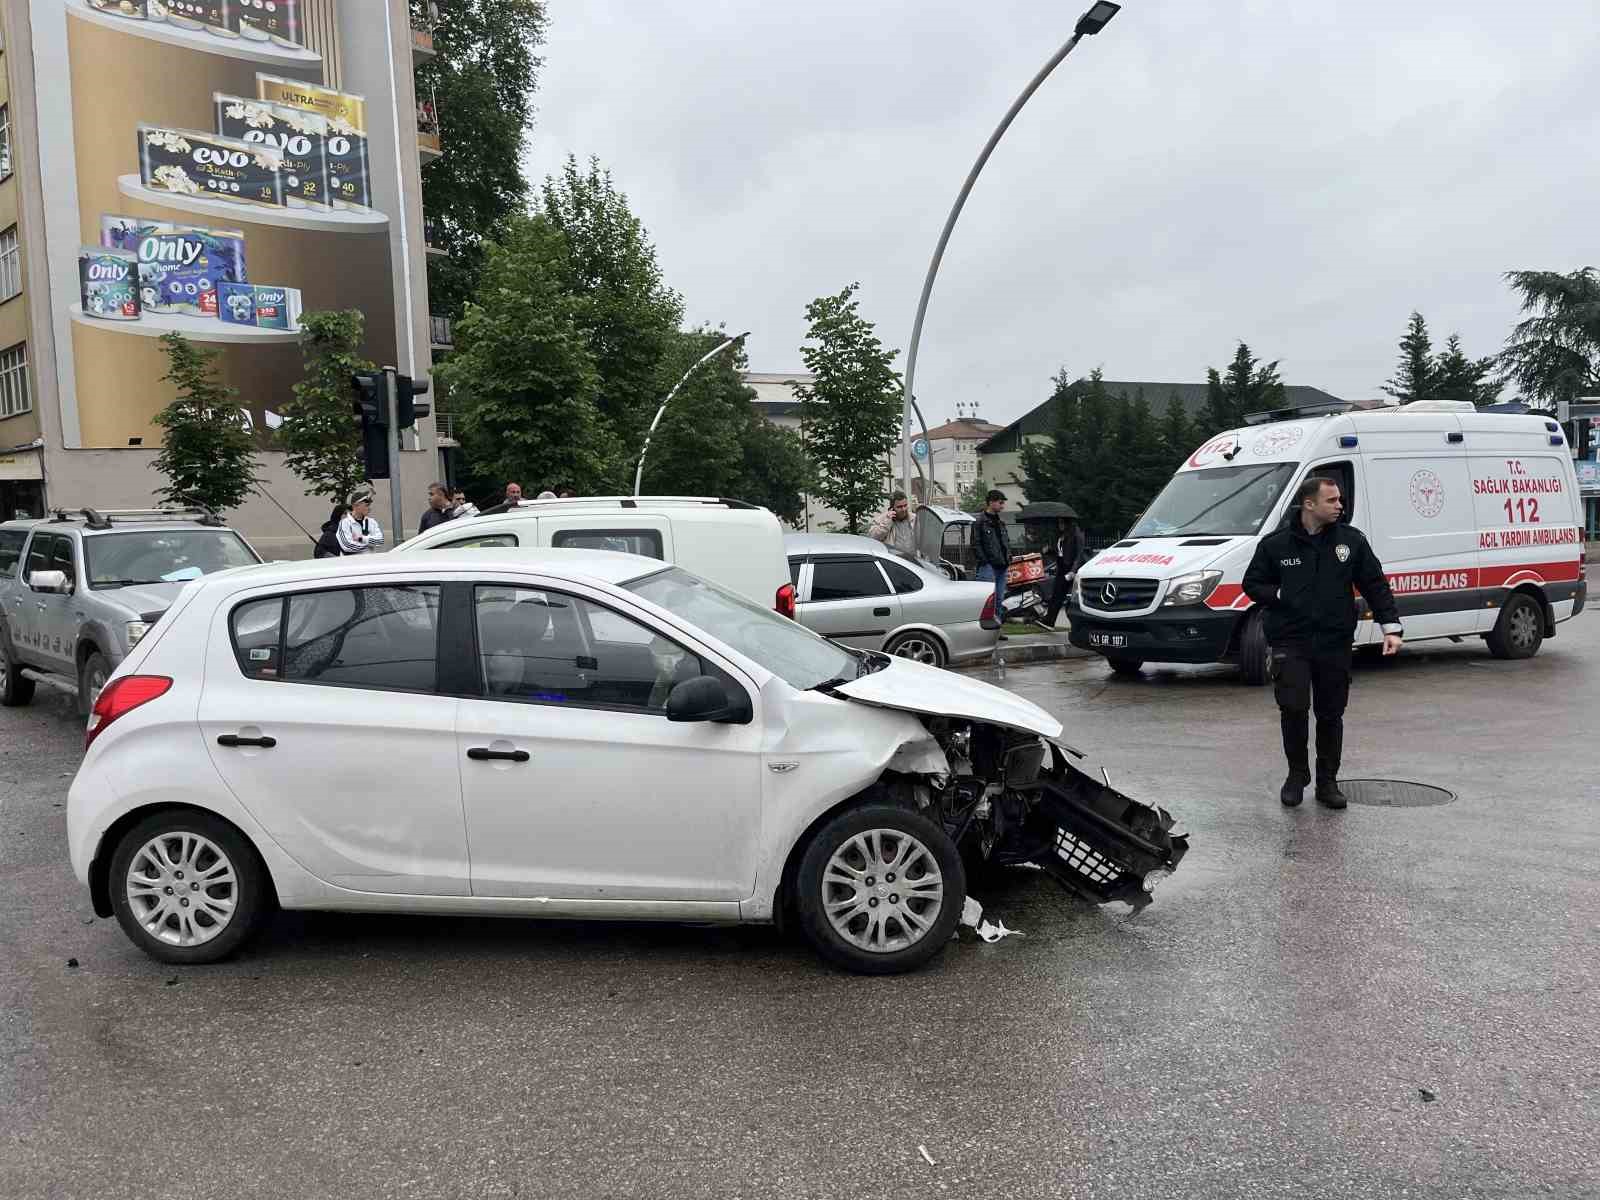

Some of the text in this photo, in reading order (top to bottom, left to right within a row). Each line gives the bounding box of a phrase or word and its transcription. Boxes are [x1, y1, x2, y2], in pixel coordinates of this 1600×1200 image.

[281, 91, 314, 105] ULTRA
[192, 147, 249, 168] evo
[342, 183, 355, 193] 40
[139, 236, 202, 265] Only
[88, 263, 128, 281] Only
[258, 291, 284, 303] Only
[1507, 460, 1526, 475] T.C.
[1473, 475, 1563, 494] SAĞLIK BAKANLIĞI
[1503, 498, 1540, 523] 112
[1499, 529, 1531, 547] YARDIM
[1388, 572, 1469, 591] AMBULANS
